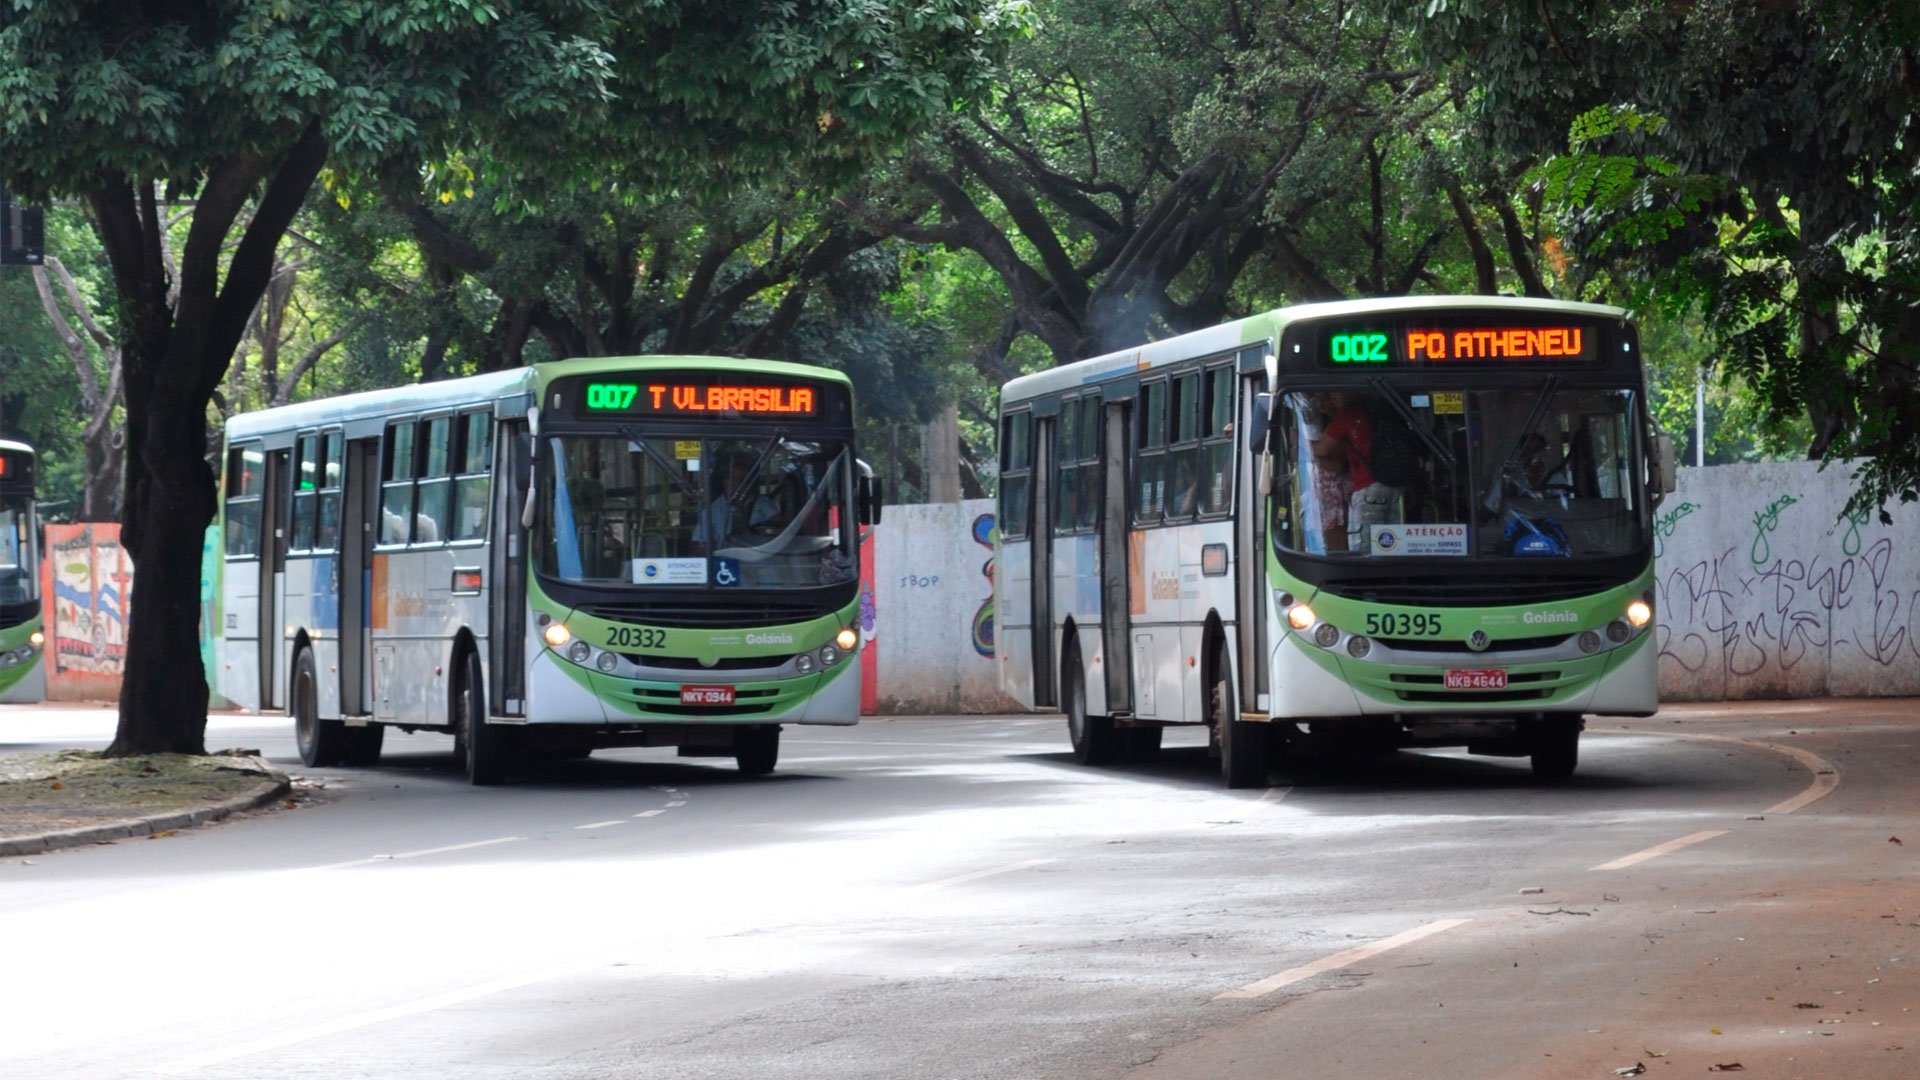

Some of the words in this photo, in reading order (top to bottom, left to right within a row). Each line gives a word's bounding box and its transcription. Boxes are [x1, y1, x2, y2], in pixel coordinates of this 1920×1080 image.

[1331, 333, 1388, 362] 002
[1407, 332, 1446, 360] PQ
[1453, 328, 1582, 358] ATHENEU
[587, 384, 638, 409] 007
[649, 386, 666, 409] T
[706, 387, 813, 412] BRASILIA
[1366, 613, 1442, 636] 50395
[606, 626, 666, 649] 20332
